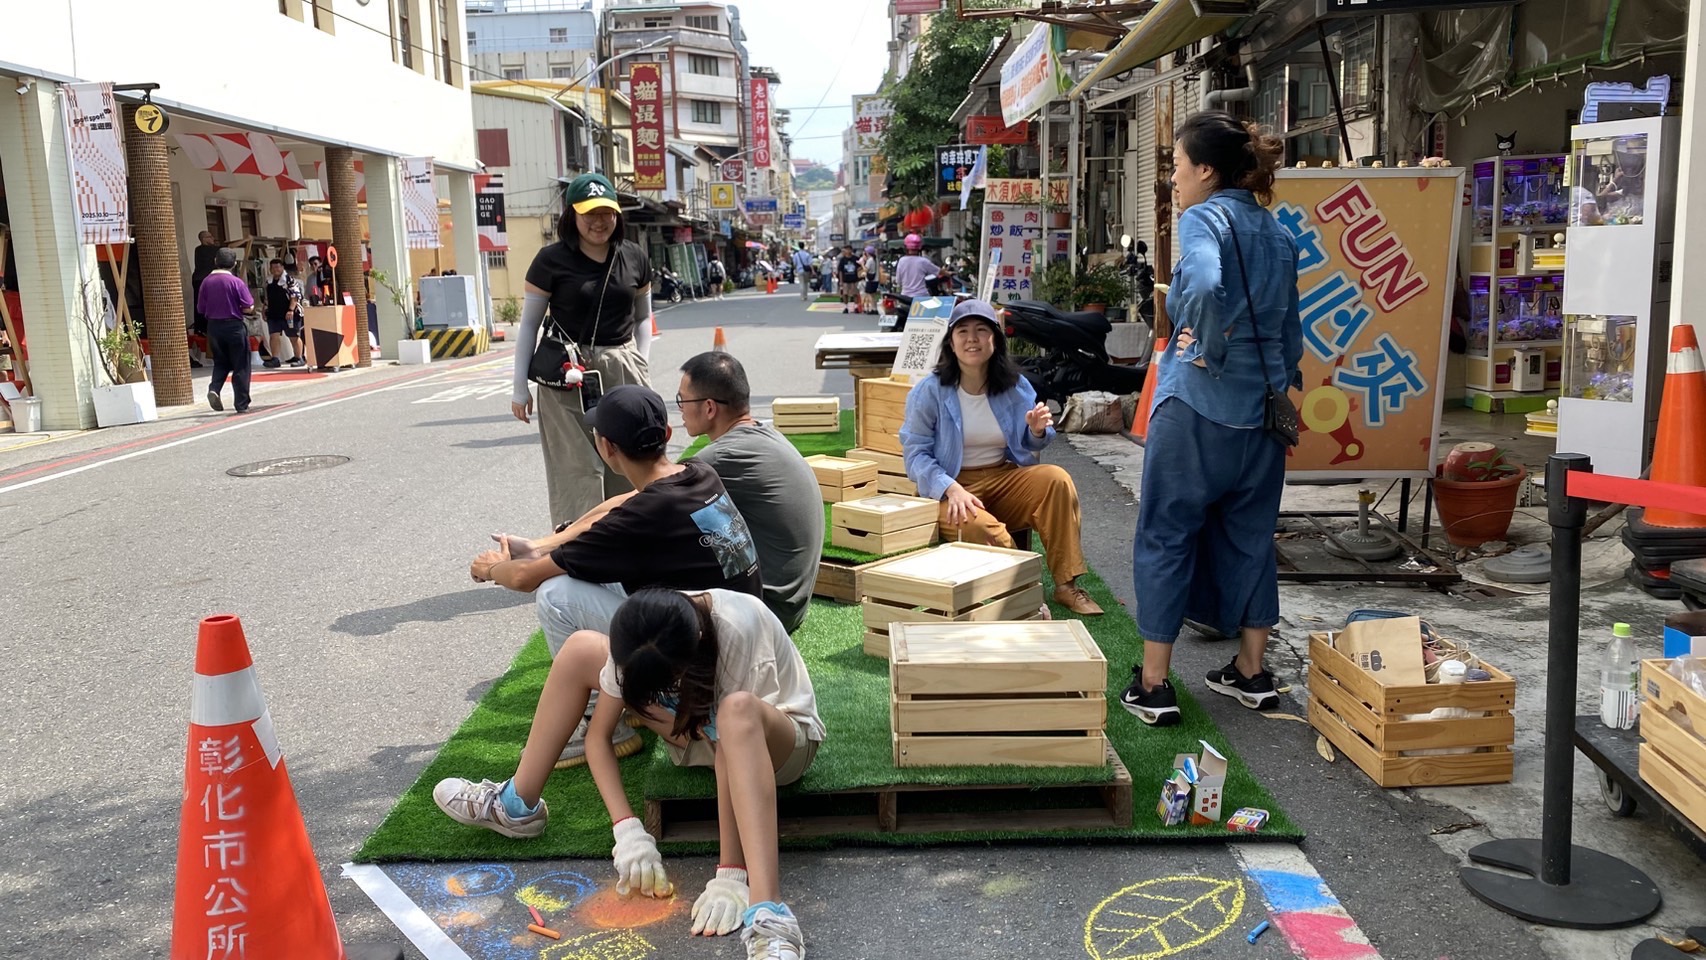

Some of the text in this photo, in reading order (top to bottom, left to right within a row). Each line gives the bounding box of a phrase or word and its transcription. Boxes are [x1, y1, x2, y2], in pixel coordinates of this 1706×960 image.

[1318, 181, 1427, 310] FUN
[198, 735, 249, 960] 彰化市公所
